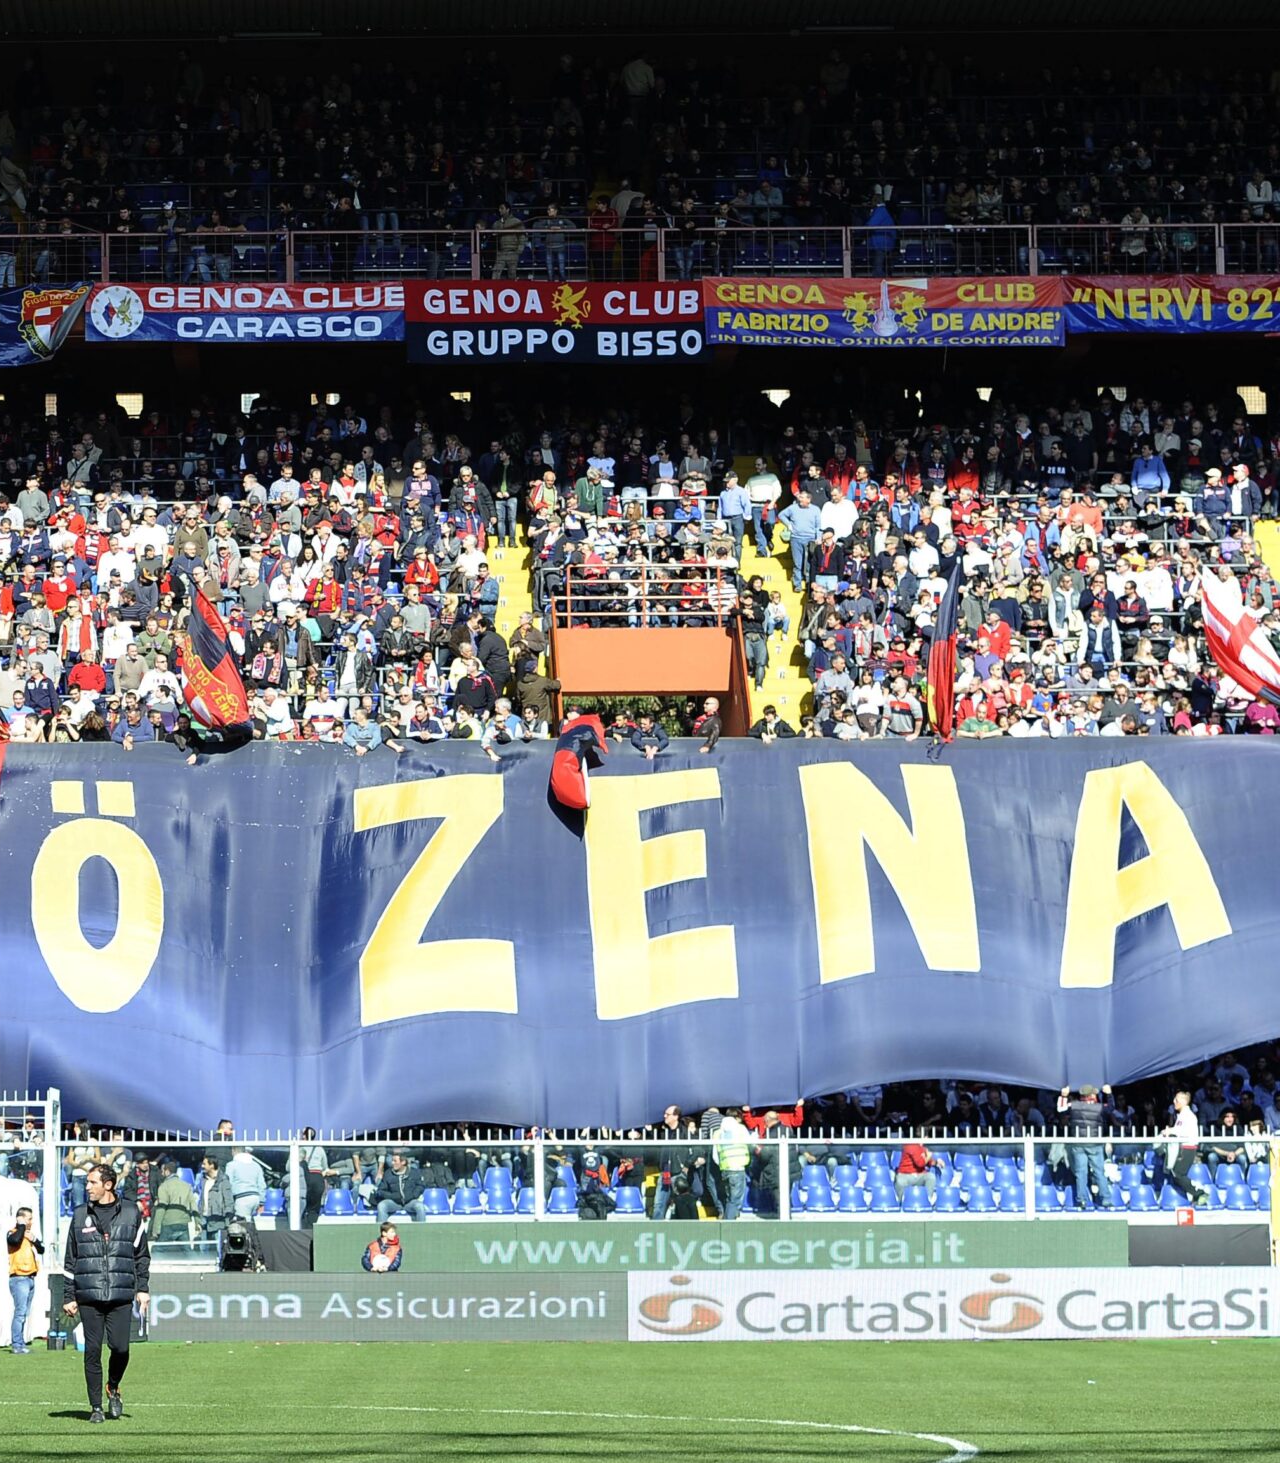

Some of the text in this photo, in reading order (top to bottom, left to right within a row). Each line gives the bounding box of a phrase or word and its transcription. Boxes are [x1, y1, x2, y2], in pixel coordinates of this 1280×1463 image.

[148, 287, 294, 308] GENOA
[424, 289, 699, 315] GENOA CLUB
[716, 283, 1036, 304] GENOA CLUB
[1072, 287, 1212, 321] "NERVI
[177, 316, 382, 338] CARASCO
[717, 312, 1061, 332] FABRIZIO DE ANDRE'
[427, 329, 702, 356] GRUPPO BISSO
[742, 335, 836, 344] DIREZIONE
[841, 336, 928, 345] OSTINATA
[934, 337, 943, 345] E
[949, 335, 1059, 344] CONTRARIA"
[353, 761, 1233, 1027] ZENA
[474, 1231, 965, 1269] www.flyenergia.it
[321, 1290, 606, 1319] Assicurazioni
[736, 1290, 948, 1333] CartaSi
[1057, 1287, 1268, 1331] CartaSi
